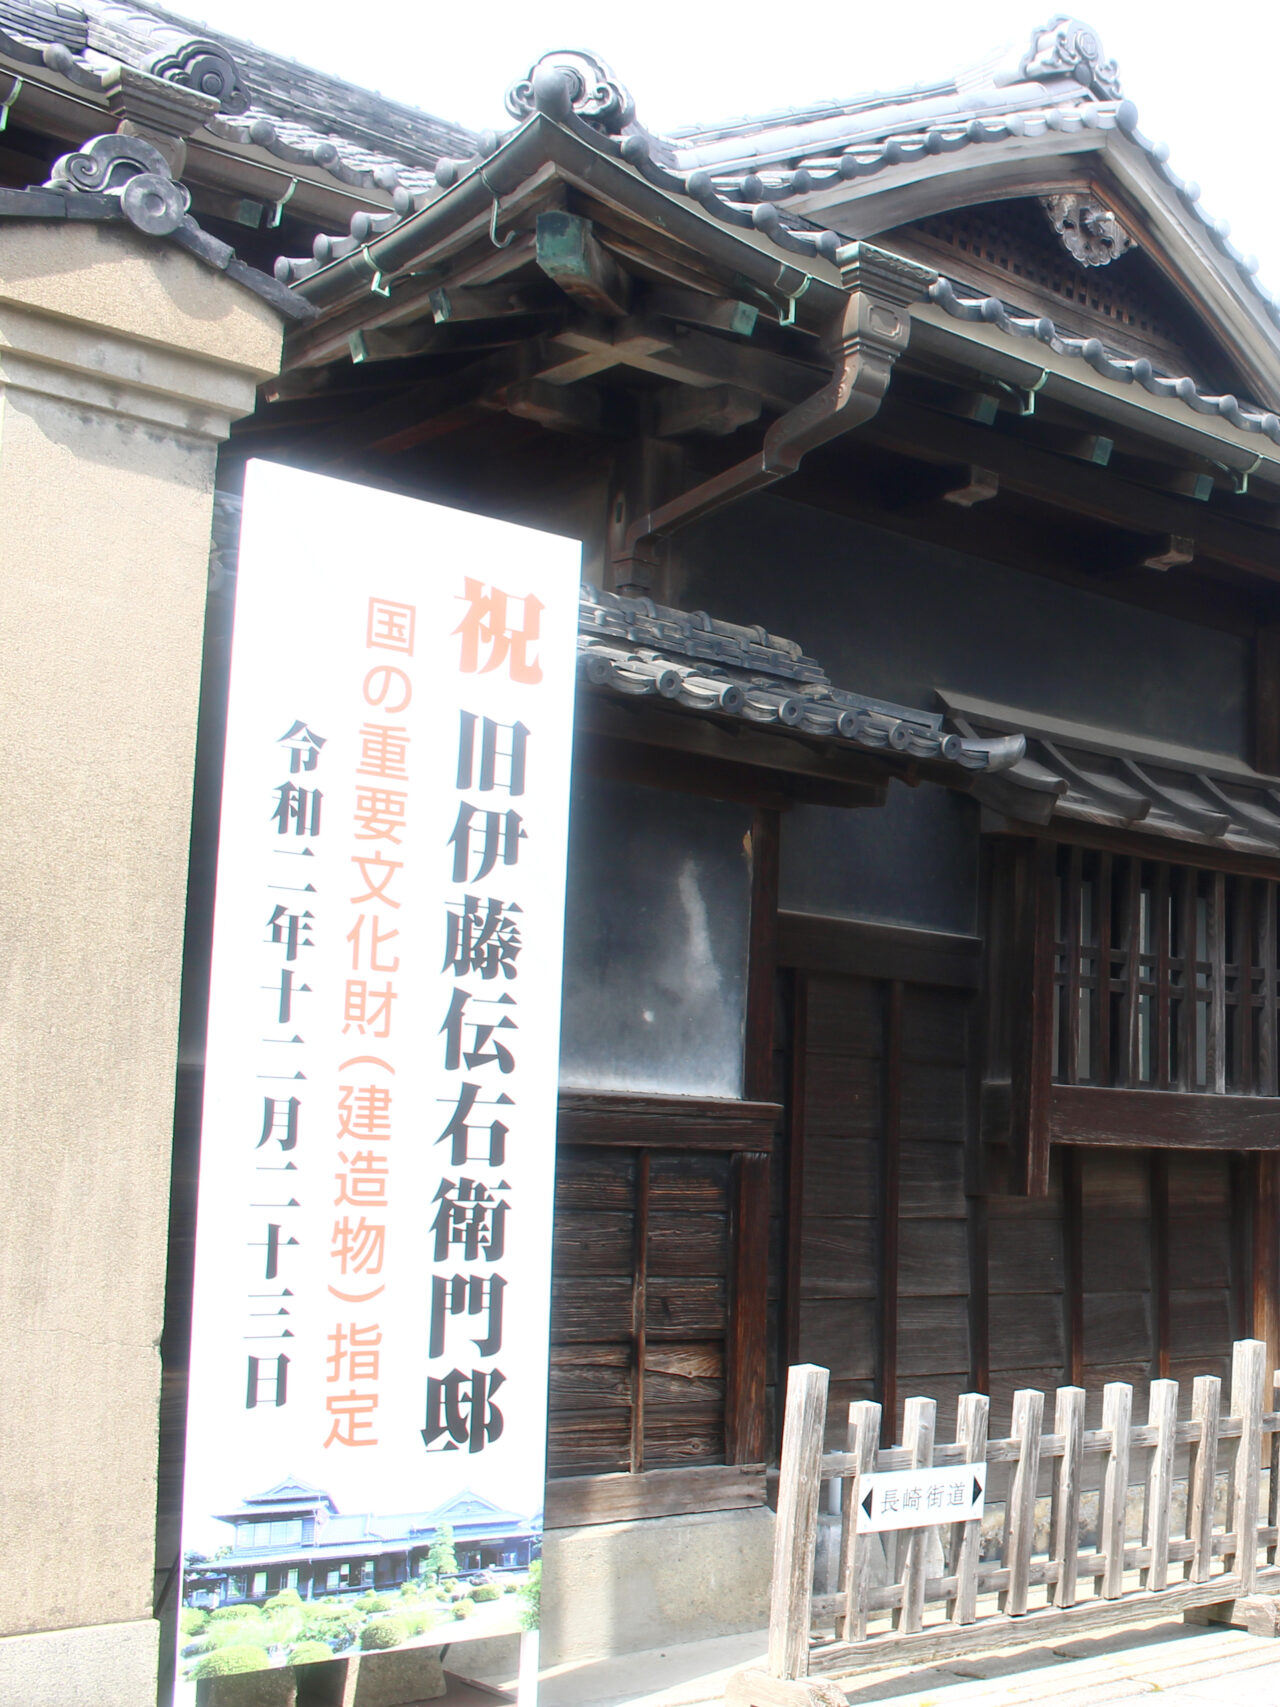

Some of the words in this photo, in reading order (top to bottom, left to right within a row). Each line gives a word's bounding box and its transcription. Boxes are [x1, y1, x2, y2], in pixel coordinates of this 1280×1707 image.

[451, 575, 545, 686] 祝
[243, 719, 328, 1410] 令和二年十二月二十三日
[420, 708, 531, 1454] 旧伊藤伝右衛門邸
[881, 1481, 966, 1514] 長崎街道
